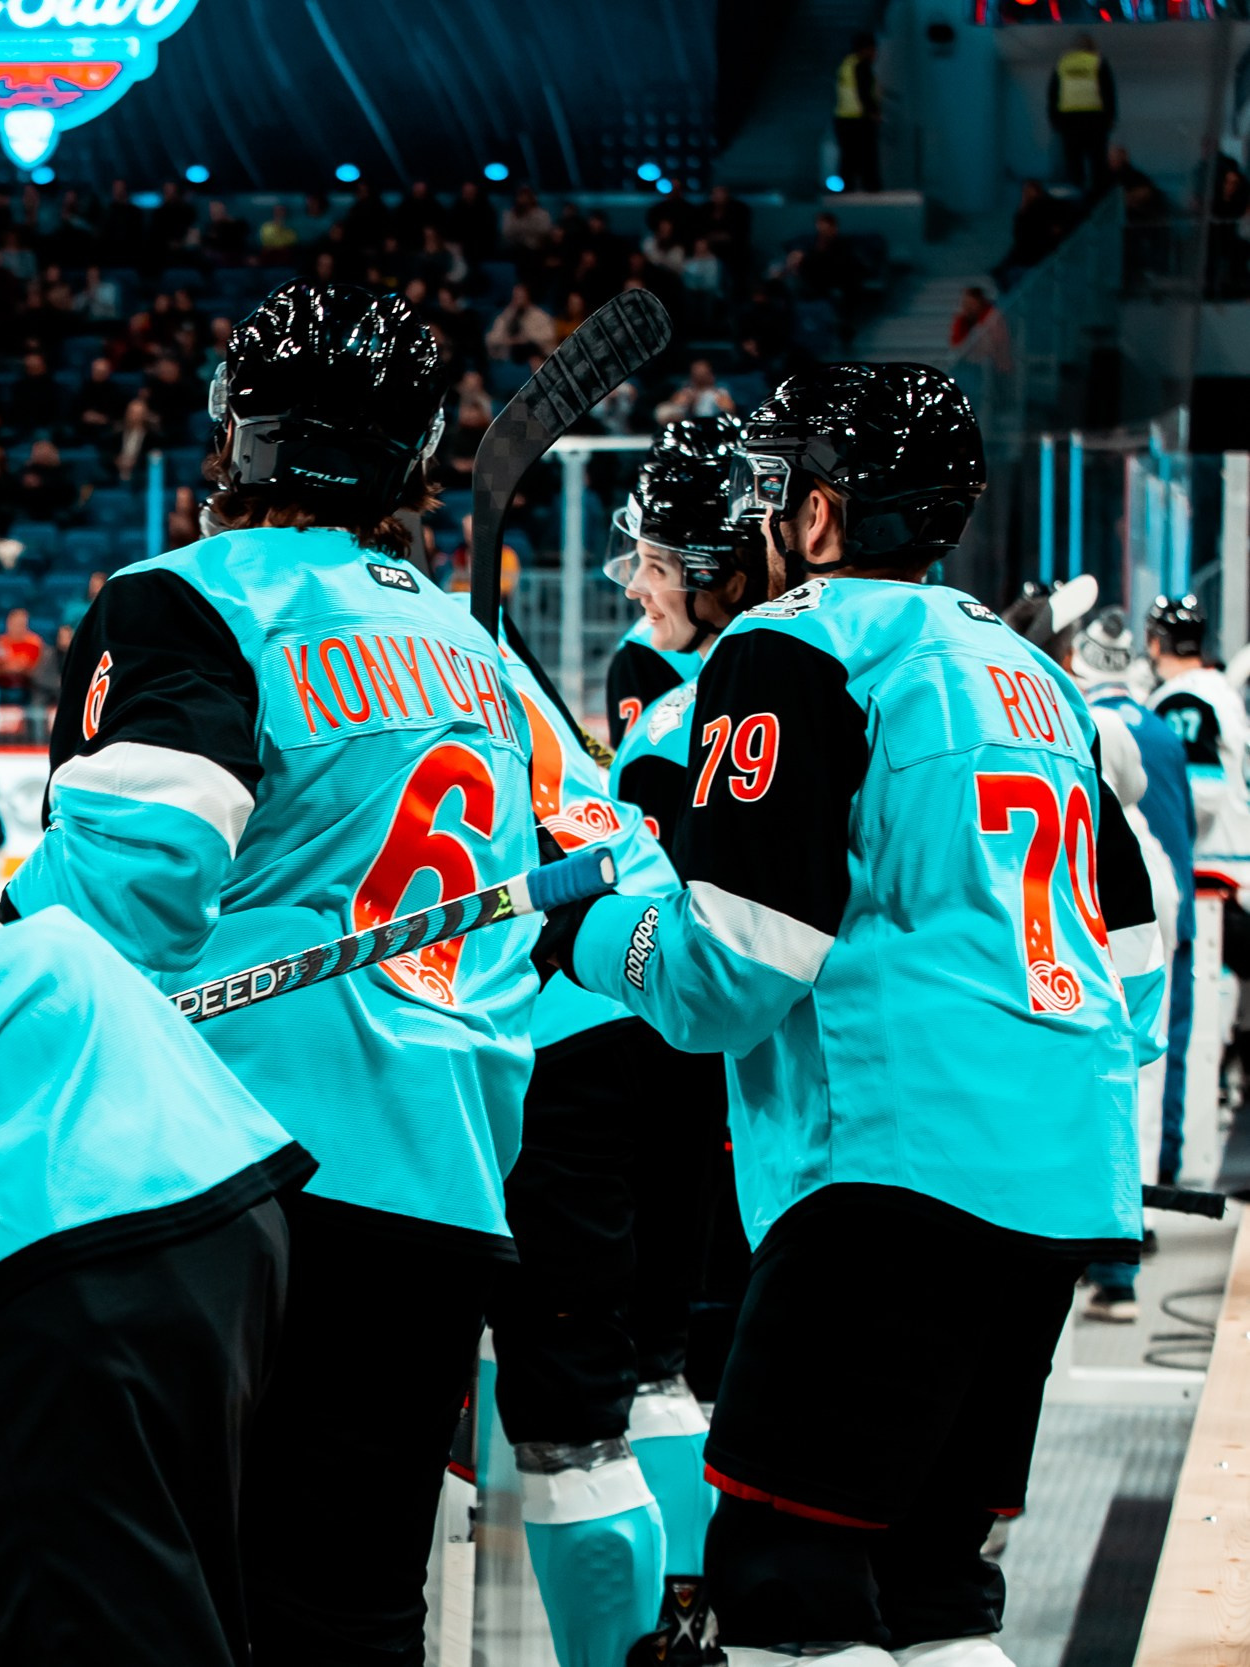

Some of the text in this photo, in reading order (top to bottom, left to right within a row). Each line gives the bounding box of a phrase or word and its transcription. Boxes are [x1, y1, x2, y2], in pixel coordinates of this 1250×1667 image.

[290, 466, 358, 485] TRUE
[83, 651, 113, 741] 6
[986, 665, 1072, 748] ROY
[692, 712, 780, 807] 79
[353, 740, 496, 1010] 6
[175, 967, 277, 1017] PEED
